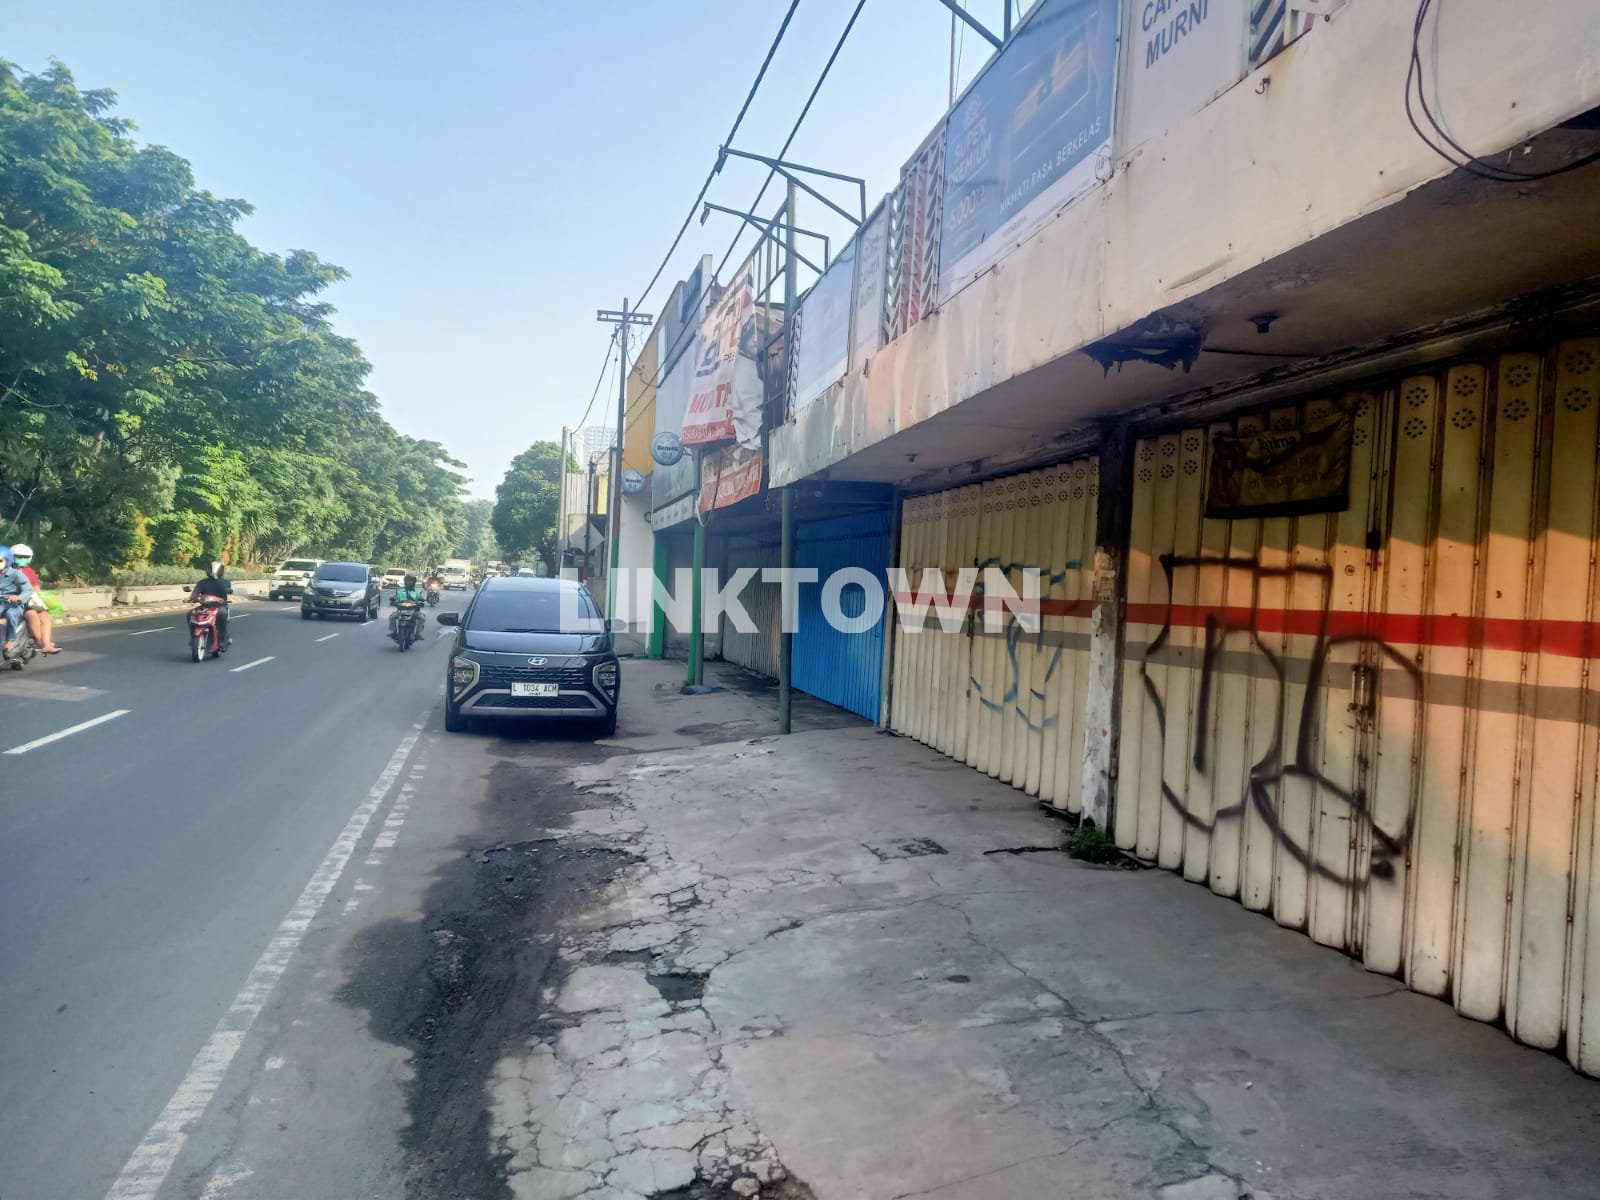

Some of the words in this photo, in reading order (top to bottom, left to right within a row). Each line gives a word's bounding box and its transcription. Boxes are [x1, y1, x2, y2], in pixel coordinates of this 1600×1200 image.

[1145, 0, 1209, 69] MURNI
[1031, 161, 1053, 186] RASA
[1056, 116, 1101, 167] BERKELAS
